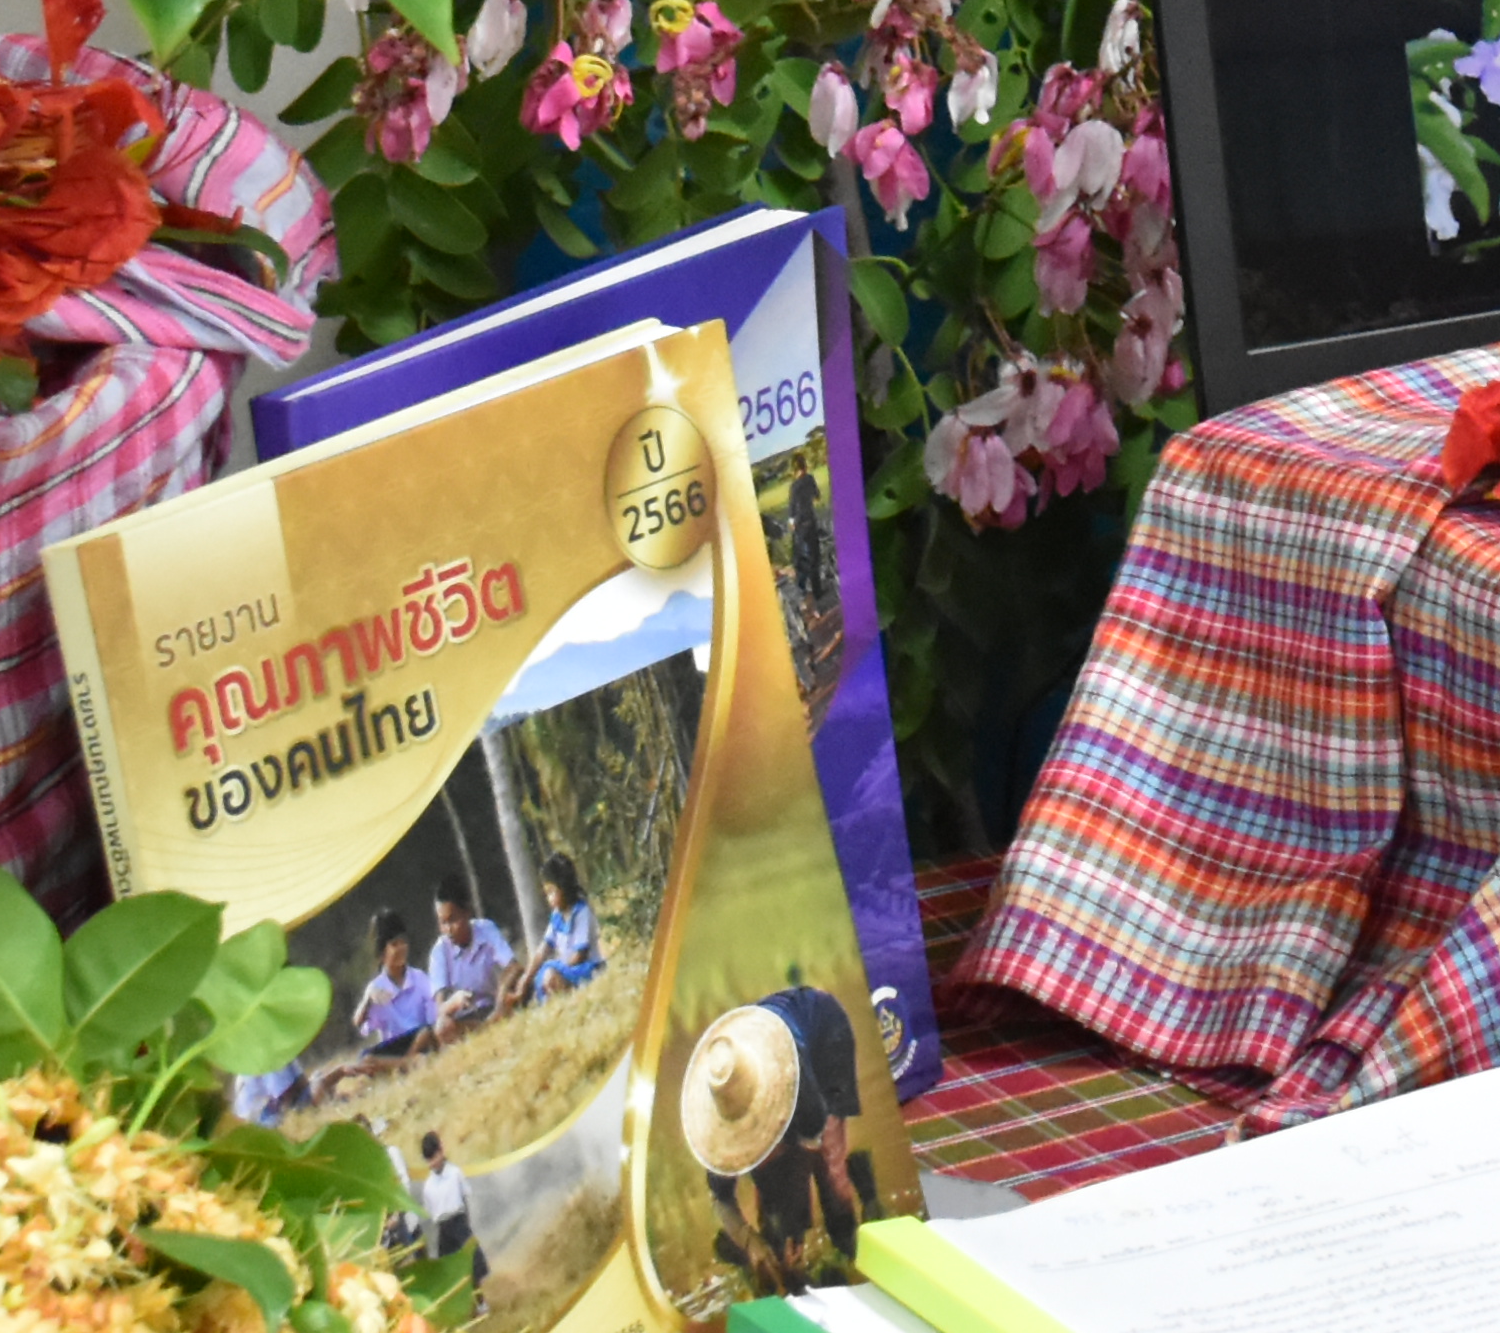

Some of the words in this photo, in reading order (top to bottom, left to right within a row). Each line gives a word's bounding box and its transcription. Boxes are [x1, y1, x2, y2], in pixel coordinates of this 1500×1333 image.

[737, 369, 818, 442] 2566
[638, 428, 666, 473] ปี
[621, 480, 708, 545] 2566
[154, 592, 281, 669] รายงาน
[169, 560, 525, 765] คุณภาพชีวิต
[184, 688, 438, 832] ของคนไทย
